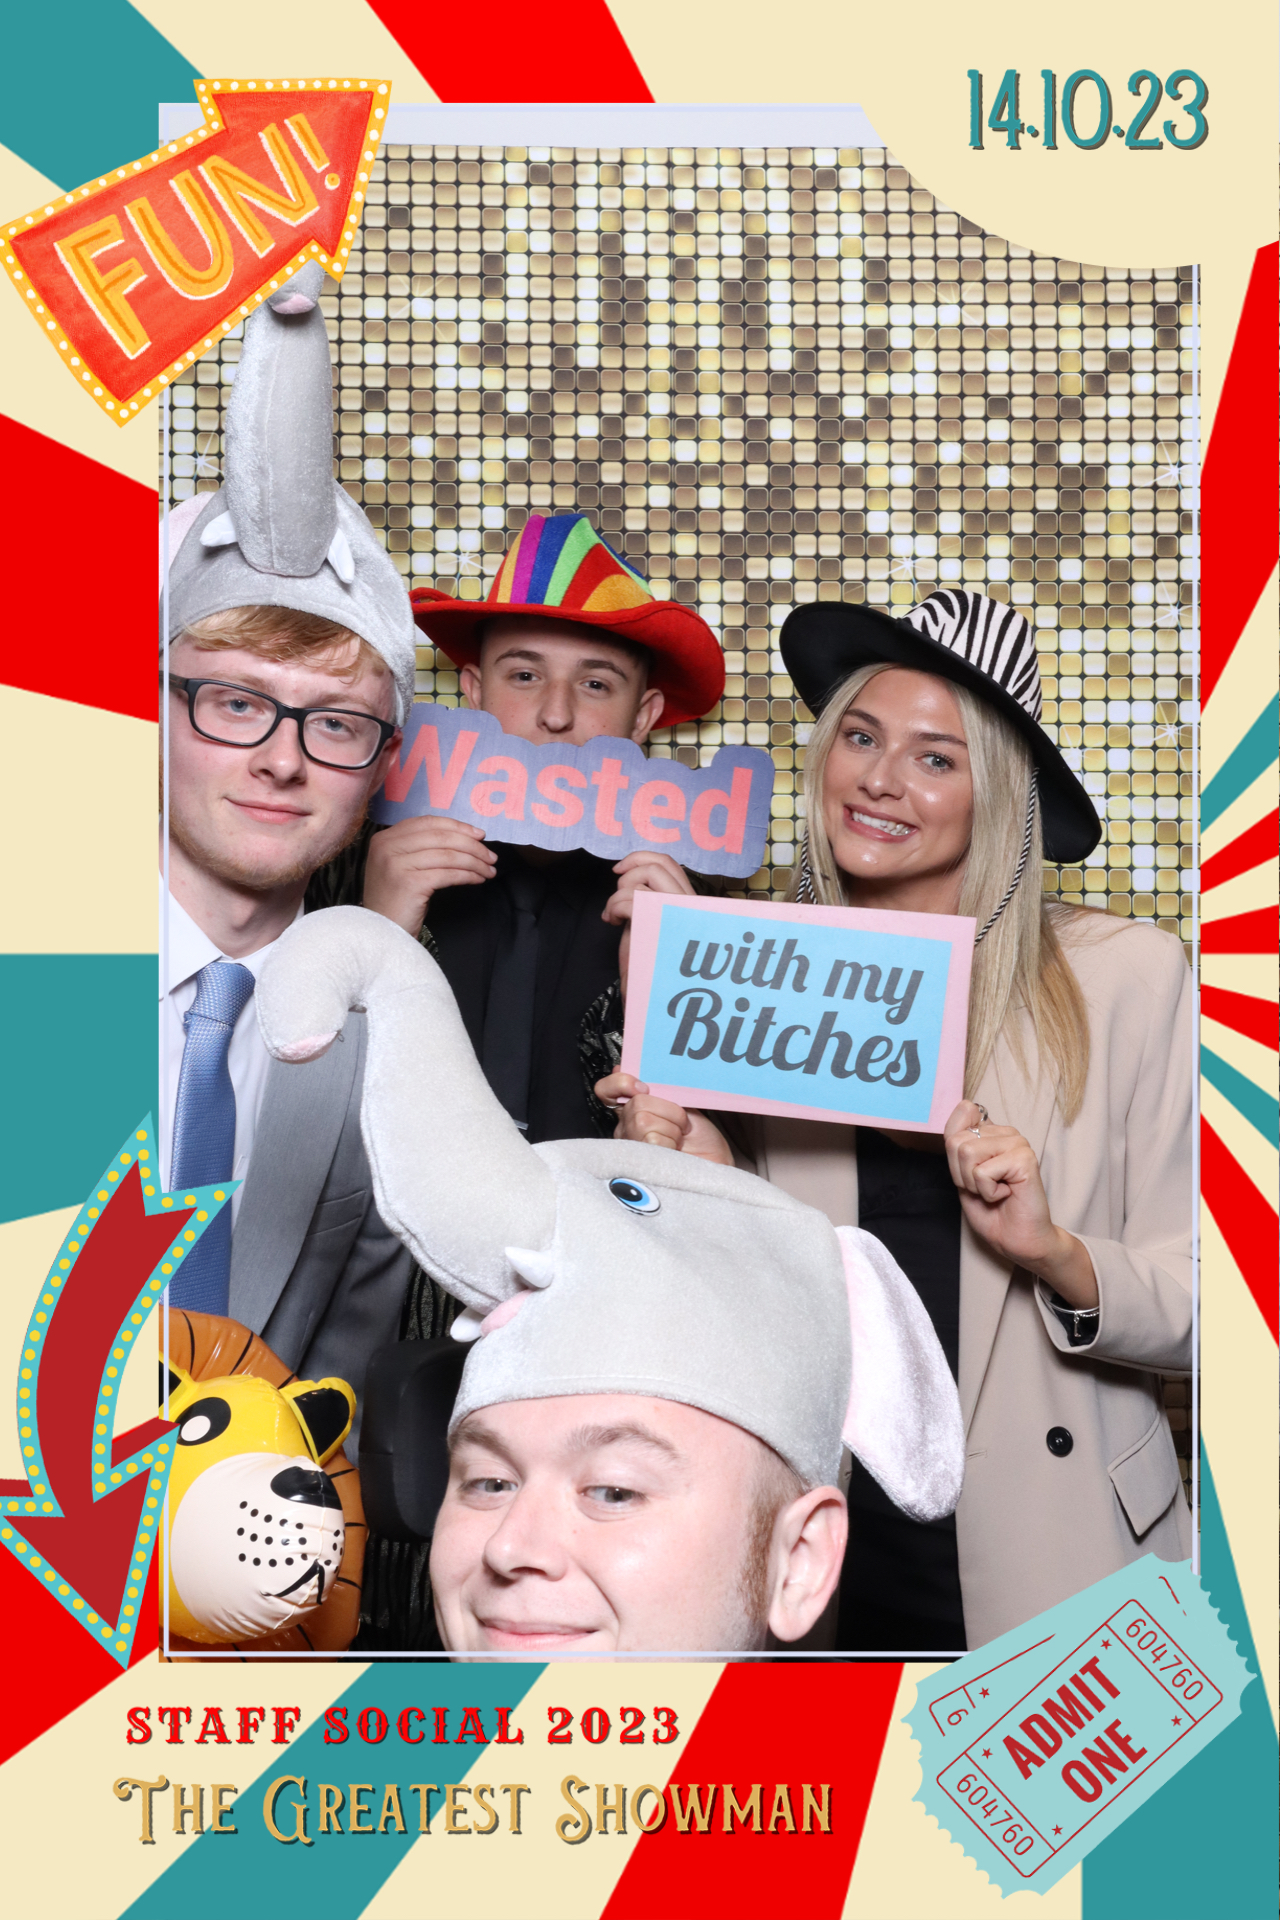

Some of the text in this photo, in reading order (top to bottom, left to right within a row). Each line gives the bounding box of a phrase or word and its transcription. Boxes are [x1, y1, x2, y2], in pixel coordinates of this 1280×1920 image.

[383, 723, 753, 855] Wasted
[679, 931, 924, 1025] with my
[667, 987, 921, 1088] Bitches
